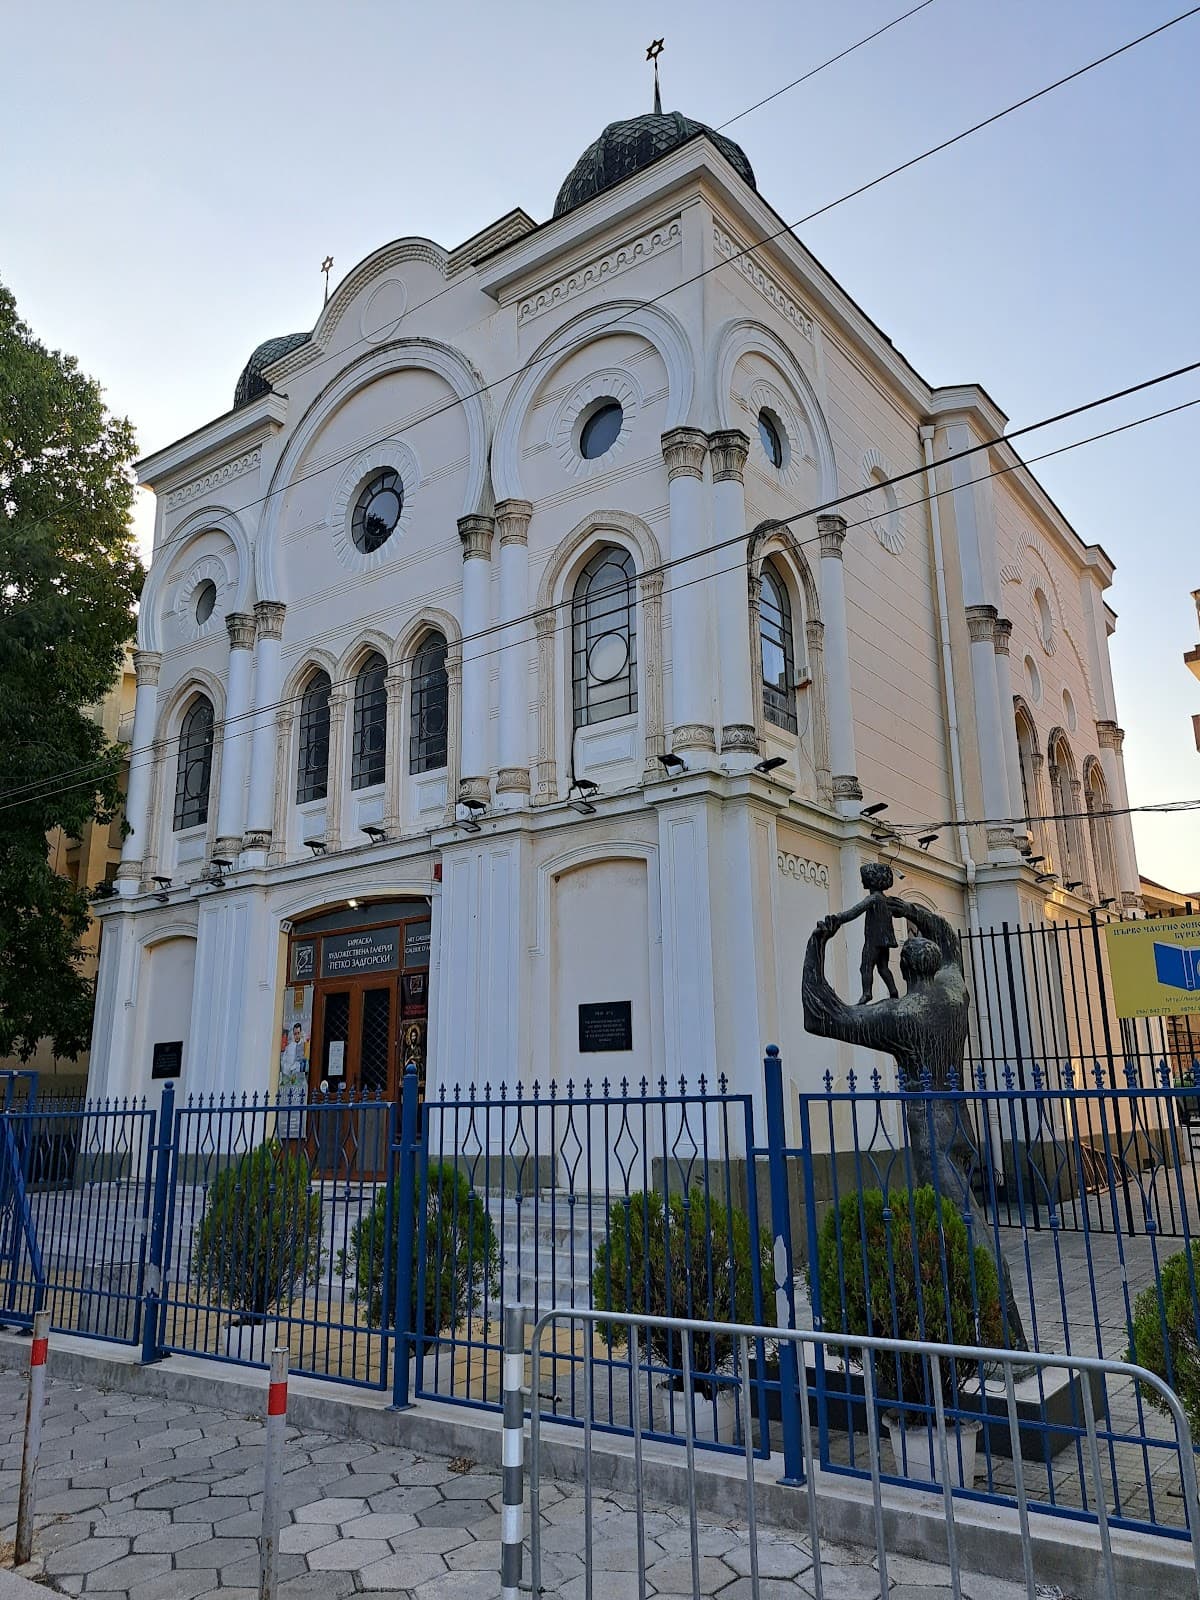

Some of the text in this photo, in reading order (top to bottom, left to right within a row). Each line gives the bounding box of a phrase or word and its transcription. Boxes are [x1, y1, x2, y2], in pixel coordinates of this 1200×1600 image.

[1113, 927, 1141, 936] ПЪРВО
[1144, 923, 1179, 933] ЧАСТНО
[347, 936, 372, 947] БУРГАСКА
[370, 943, 393, 954] ГАЛЕРИЯ
